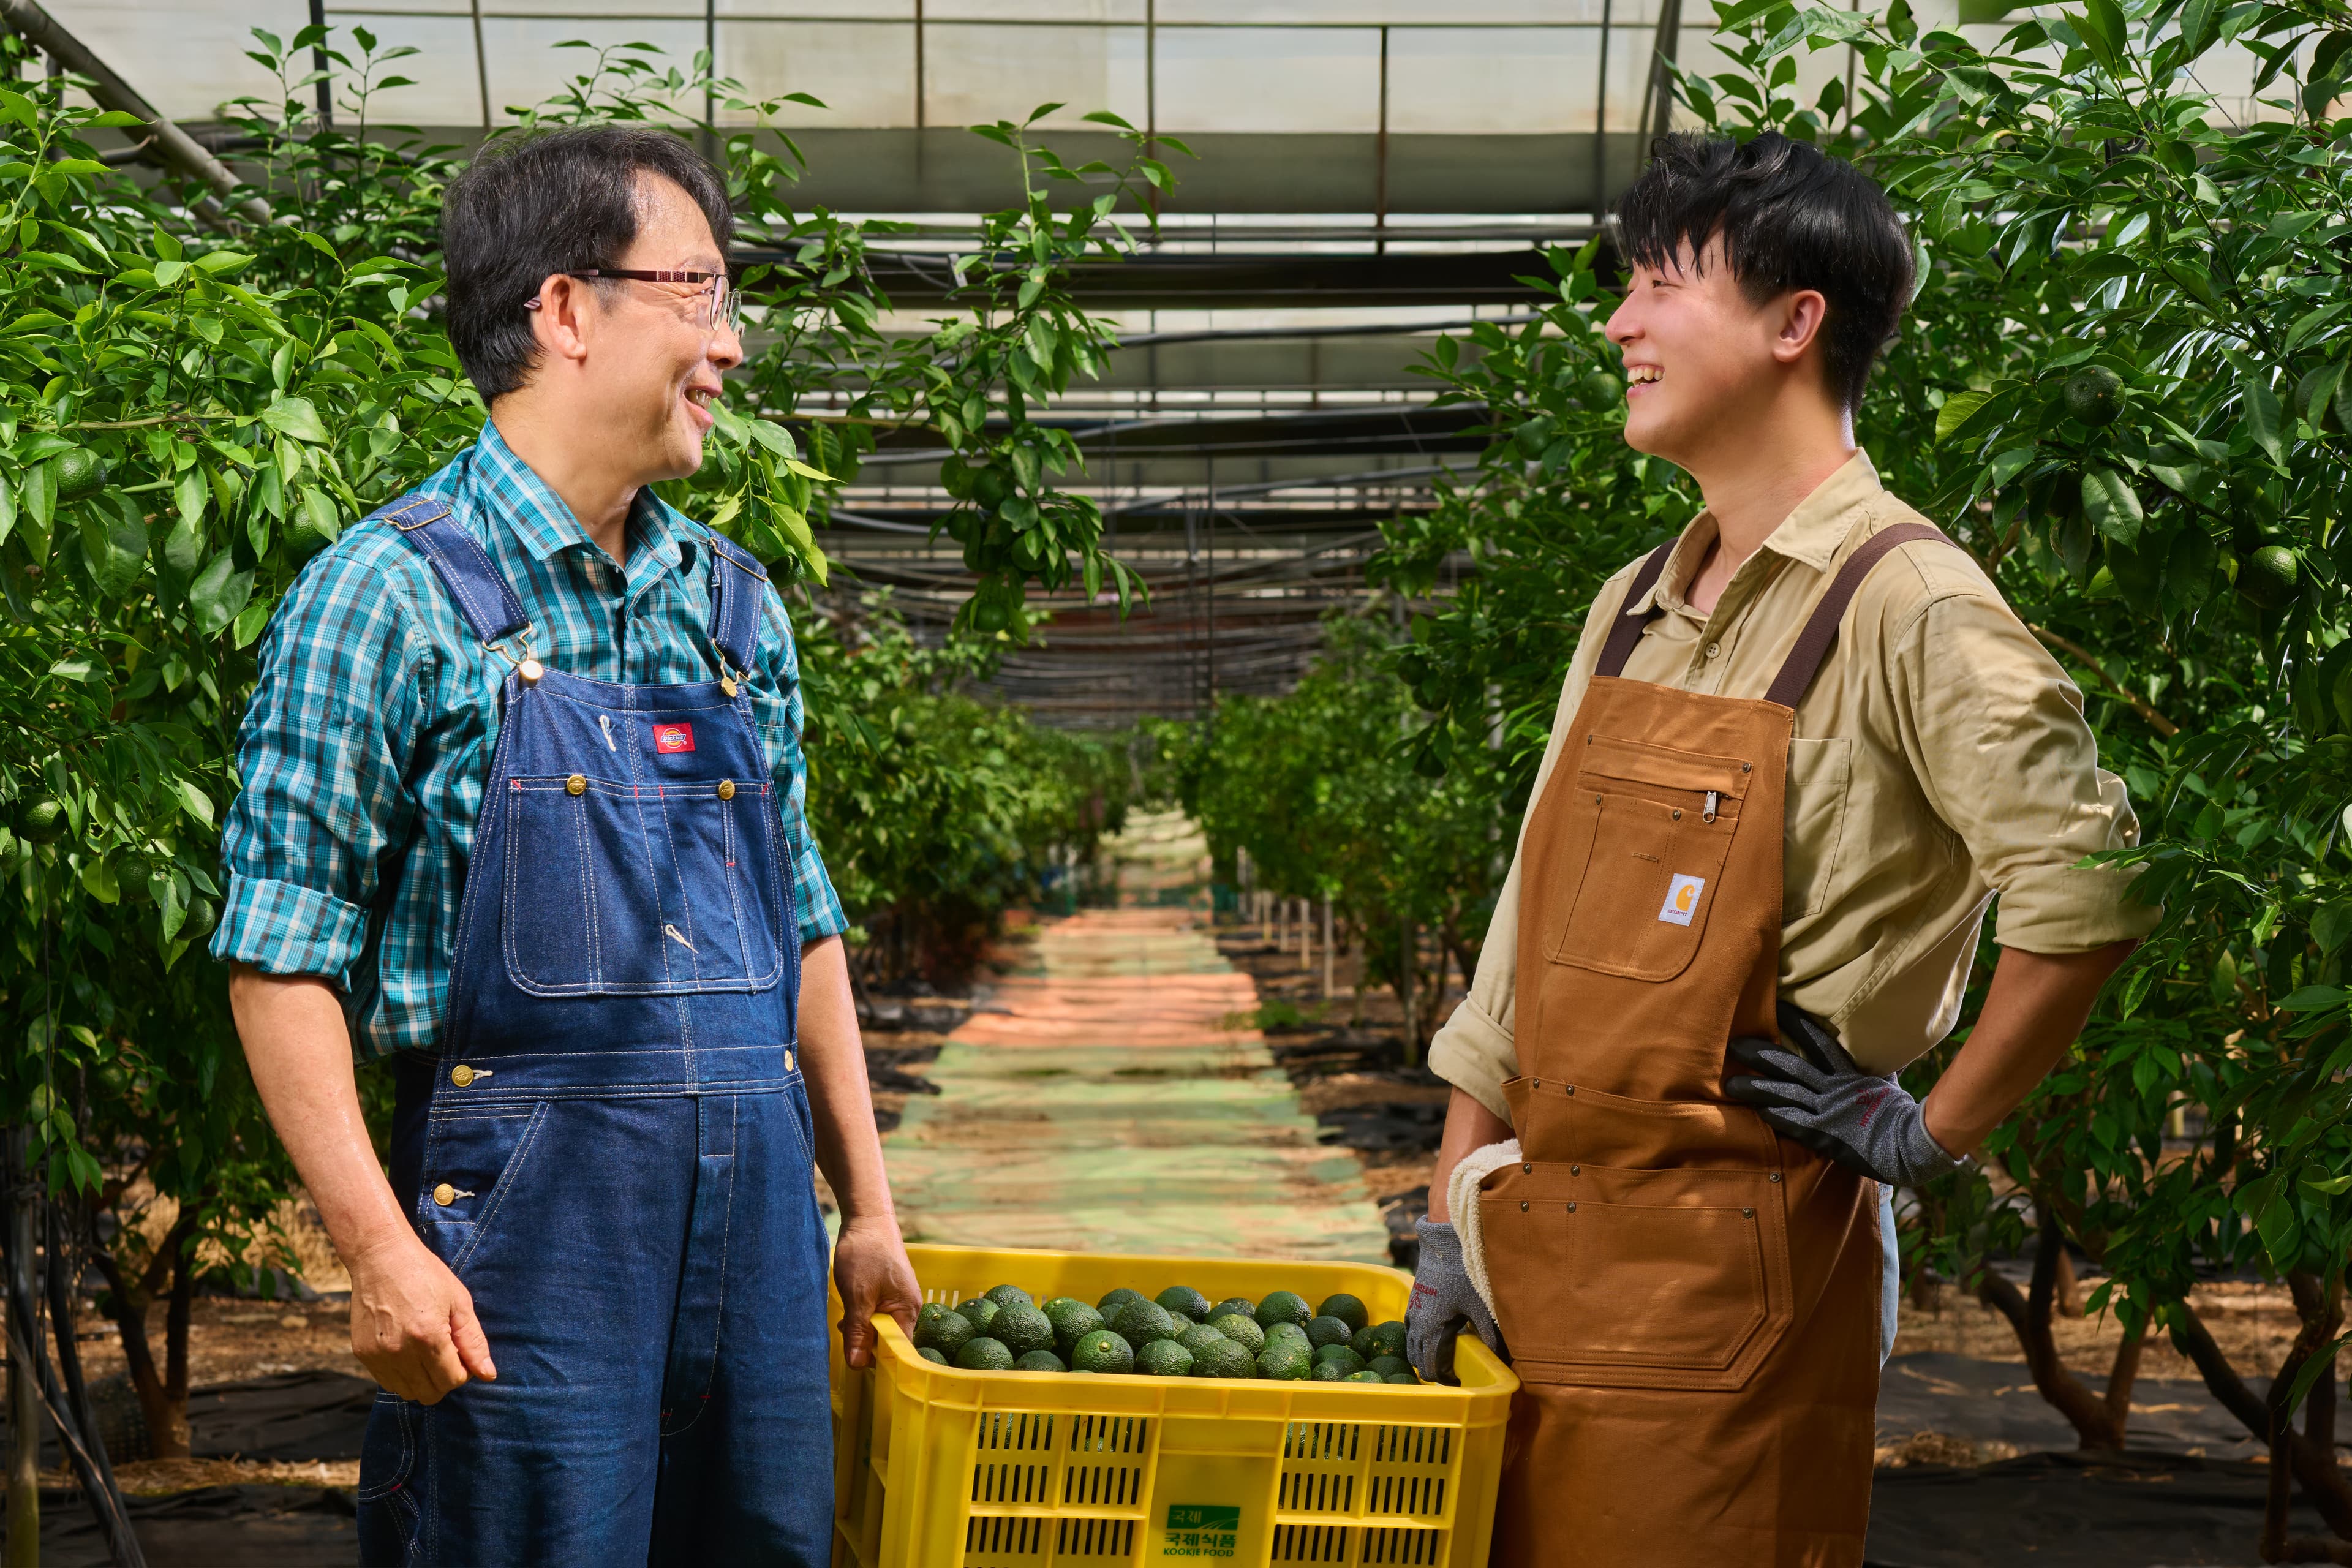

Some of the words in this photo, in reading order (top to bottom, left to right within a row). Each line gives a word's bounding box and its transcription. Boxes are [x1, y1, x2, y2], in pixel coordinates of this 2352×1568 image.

[1170, 1510, 1202, 1524] 국제
[1164, 1532, 1237, 1548] 국제식품
[1163, 1548, 1201, 1557] KOOKJE
[1204, 1549, 1234, 1558] FOOD
